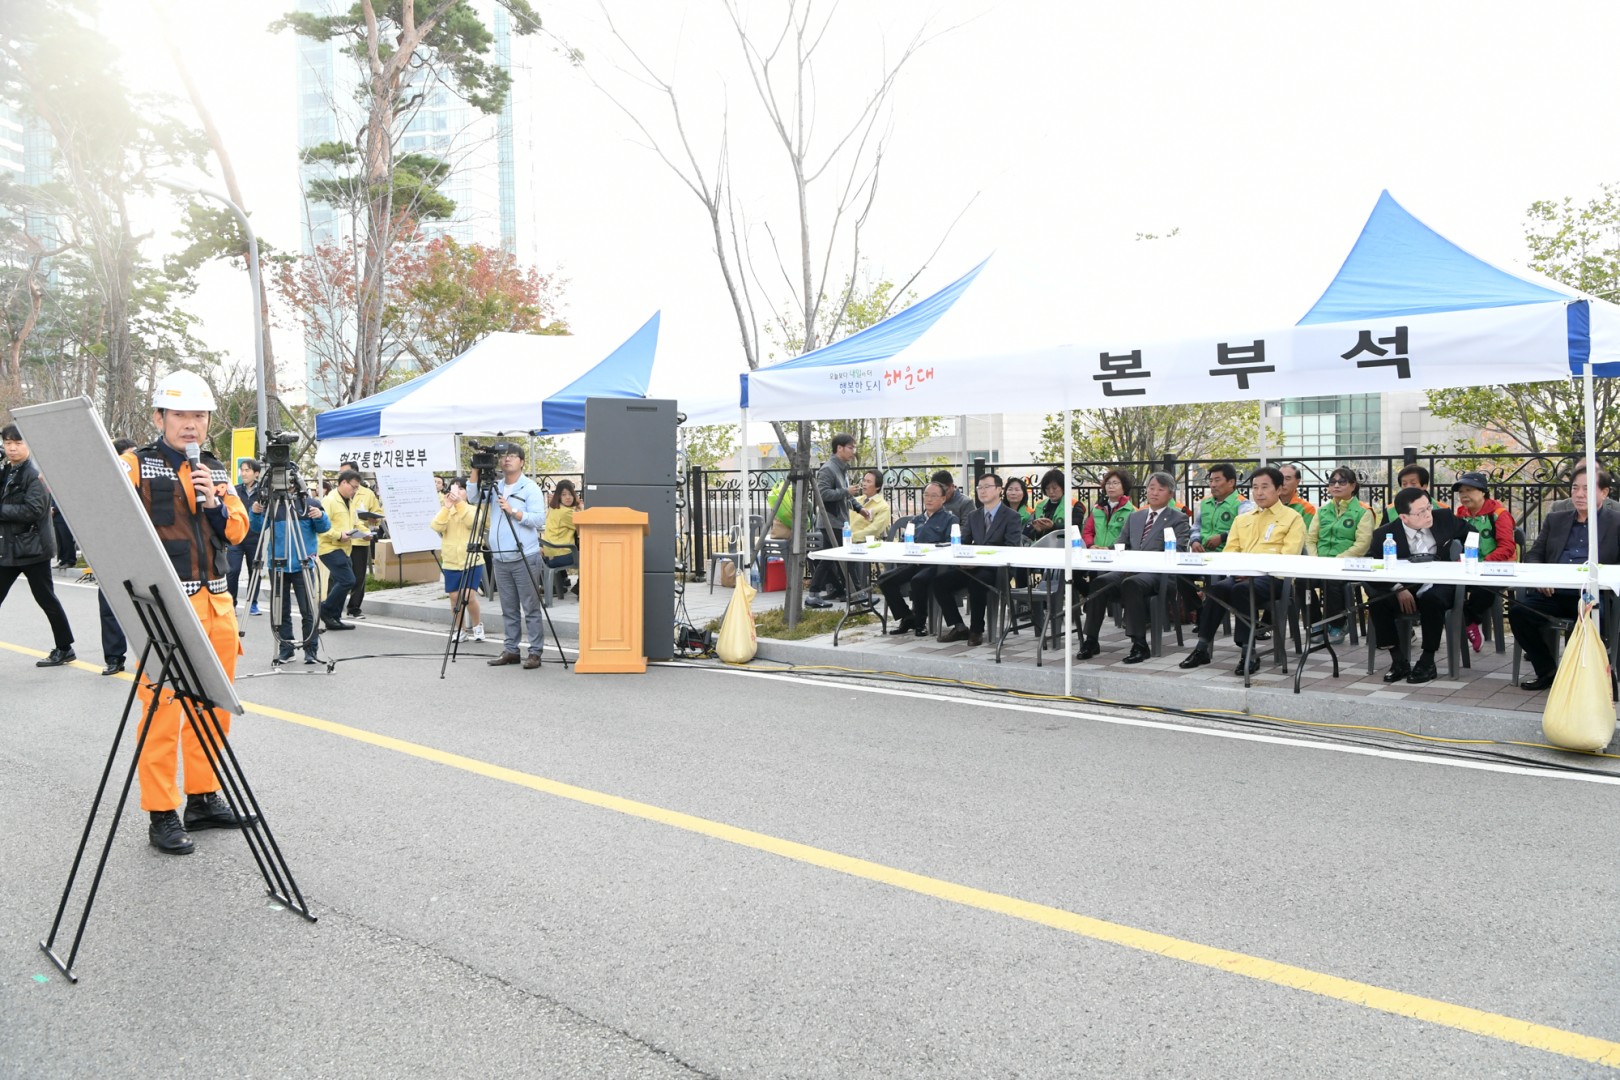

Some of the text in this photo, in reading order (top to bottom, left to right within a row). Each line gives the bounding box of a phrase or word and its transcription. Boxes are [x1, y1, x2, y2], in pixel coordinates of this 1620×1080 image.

[1092, 325, 1411, 397] 본부석
[839, 380, 881, 395] 행복한 도시
[884, 365, 934, 391] 해운대
